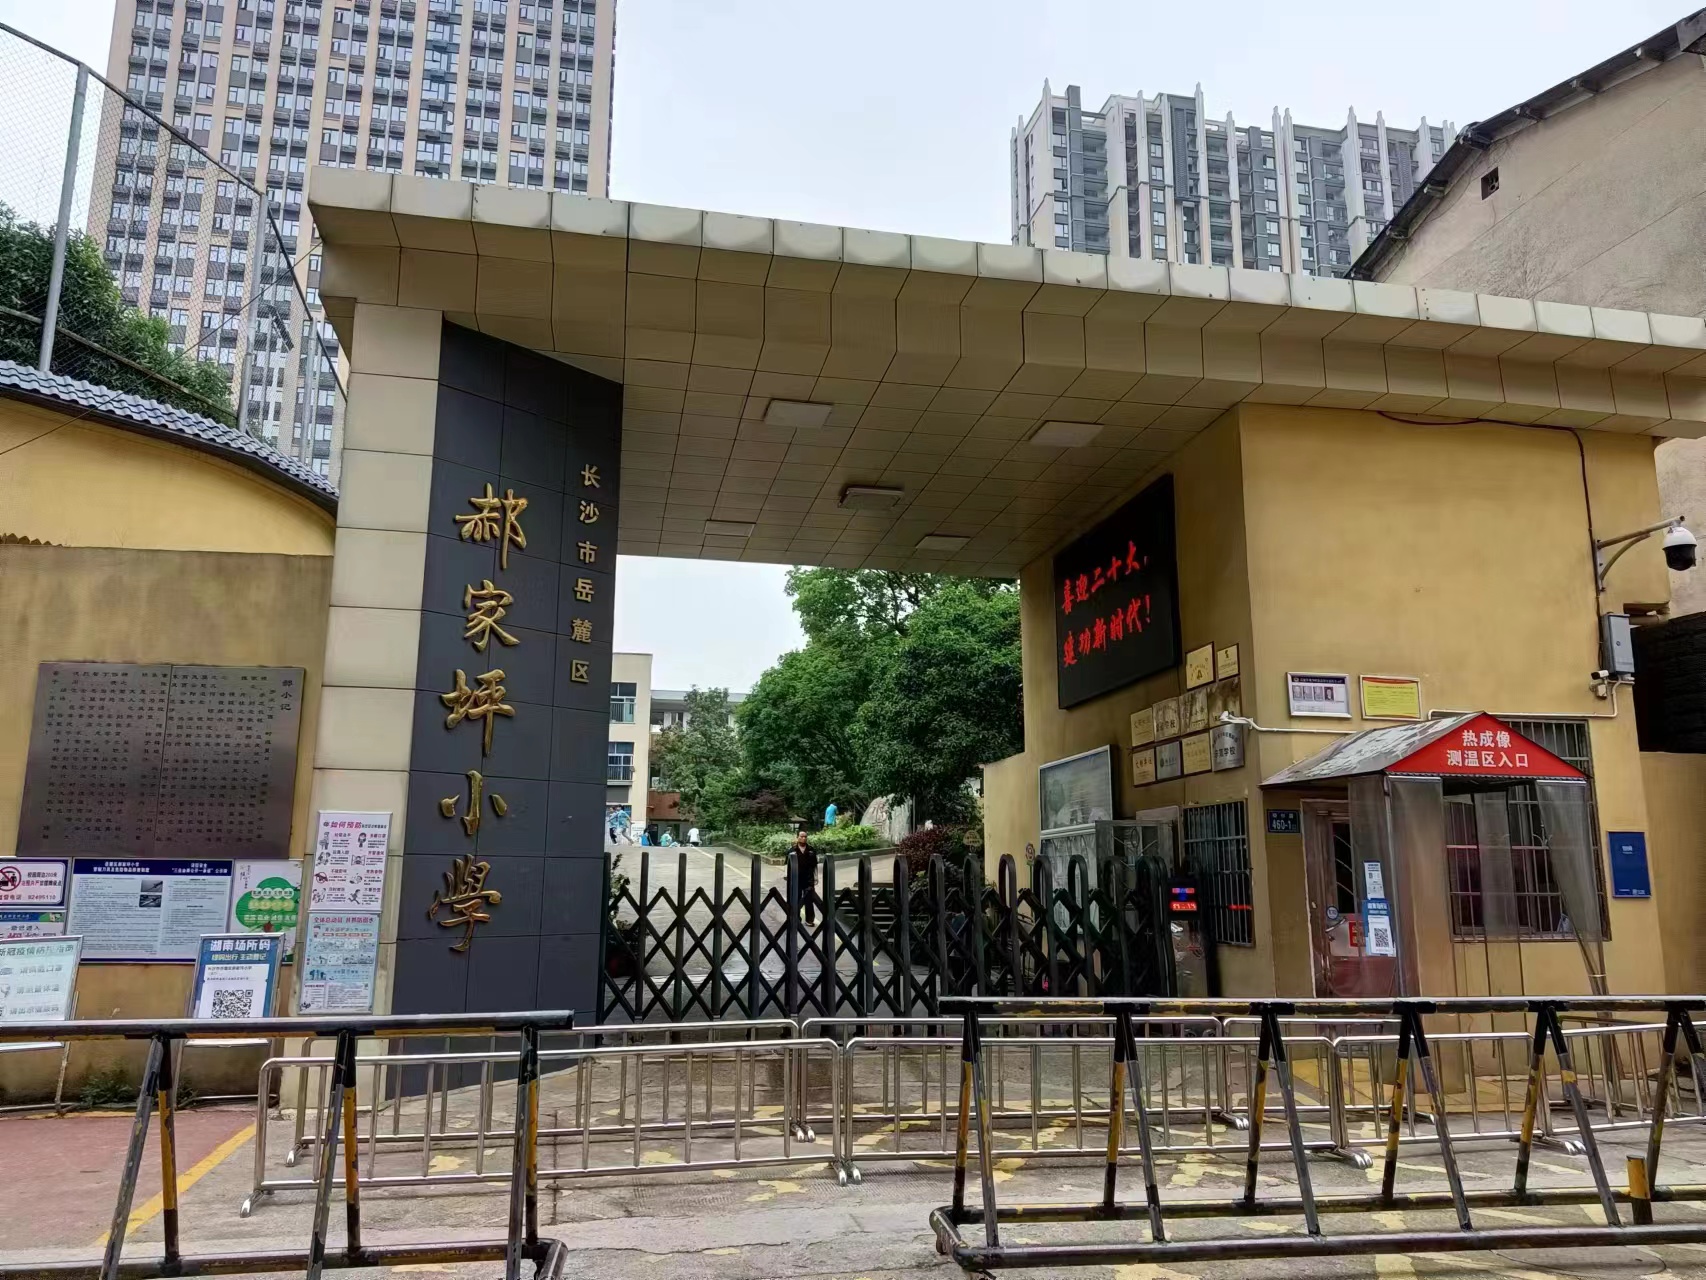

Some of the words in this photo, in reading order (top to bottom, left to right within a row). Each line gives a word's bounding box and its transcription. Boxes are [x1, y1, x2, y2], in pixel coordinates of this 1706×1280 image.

[570, 464, 600, 683] 长沙市岳麓区
[1462, 730, 1512, 748] 热成像
[1446, 749, 1529, 768] 测温区入口
[330, 820, 362, 829] 如何预防
[210, 939, 271, 952] 湖南场所码
